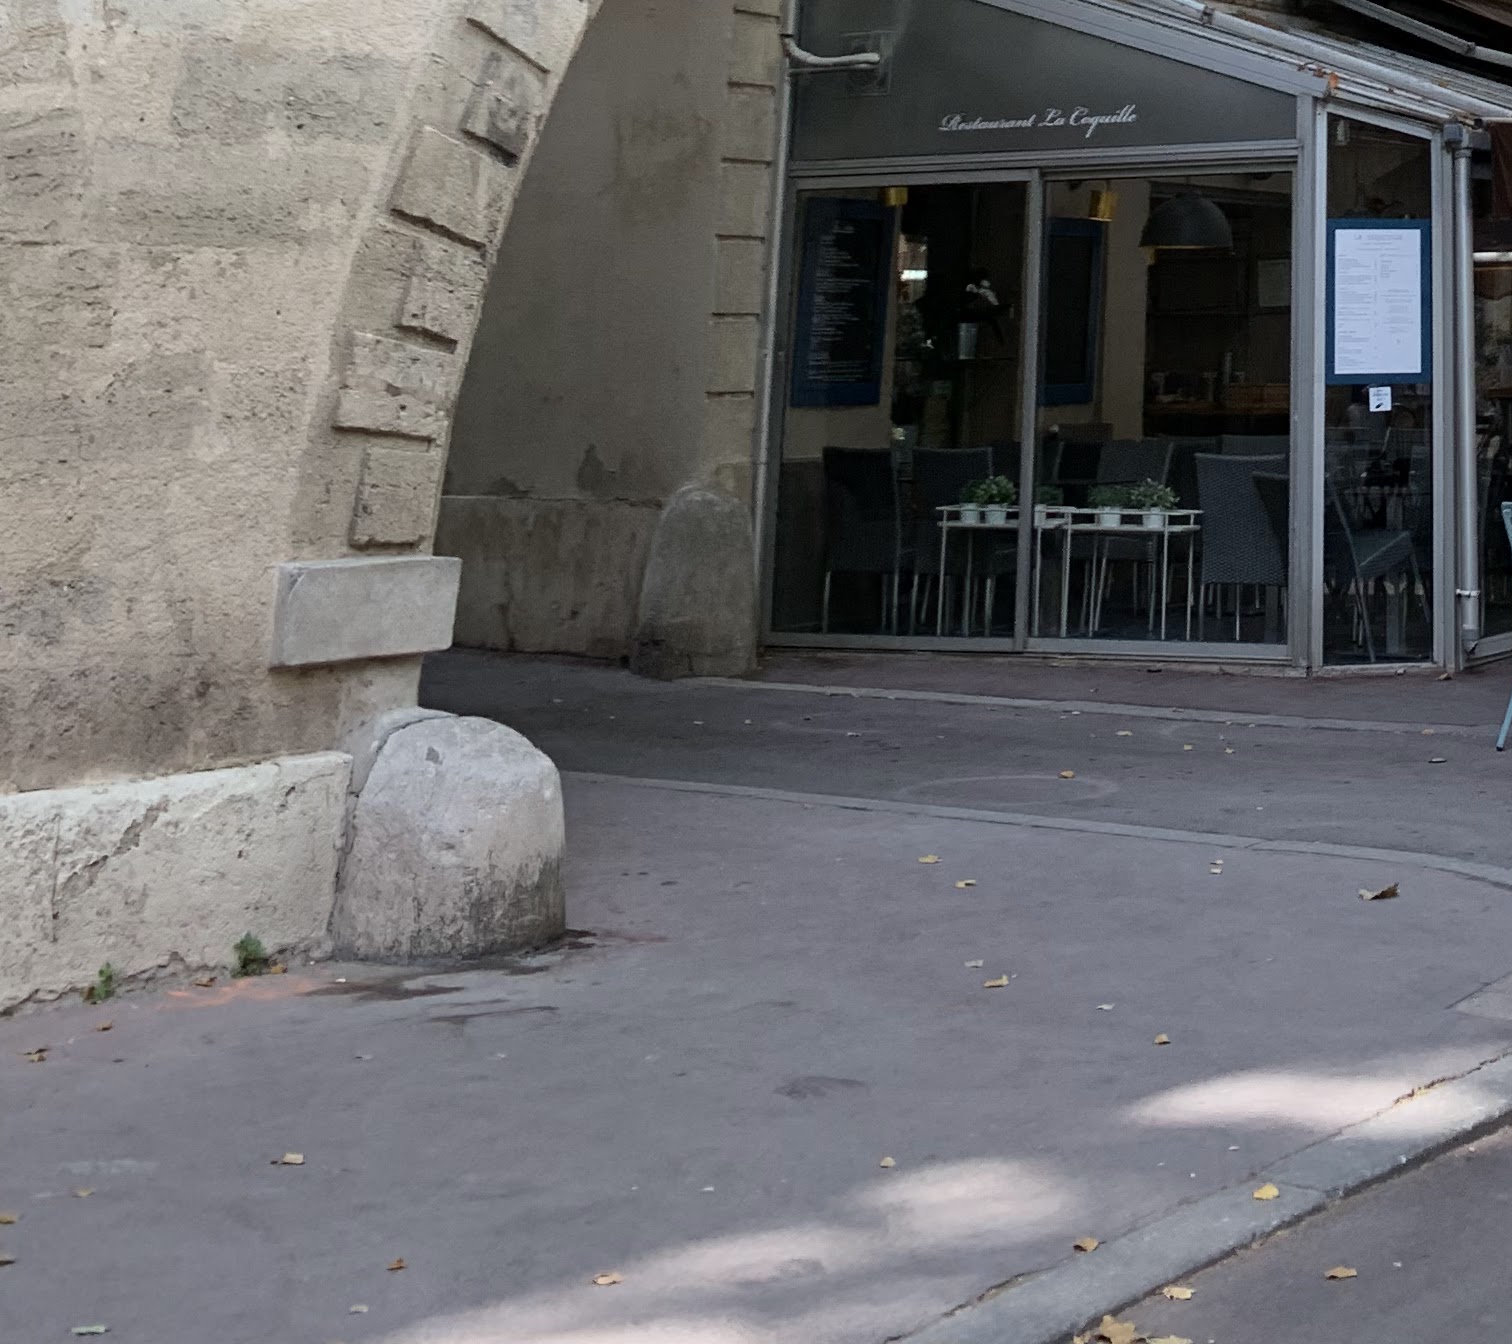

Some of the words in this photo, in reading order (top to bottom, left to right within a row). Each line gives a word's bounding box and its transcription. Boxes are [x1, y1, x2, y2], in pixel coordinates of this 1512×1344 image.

[938, 112, 1037, 132] Restaurant
[1038, 108, 1064, 127] La
[1069, 105, 1137, 138] Coquille
